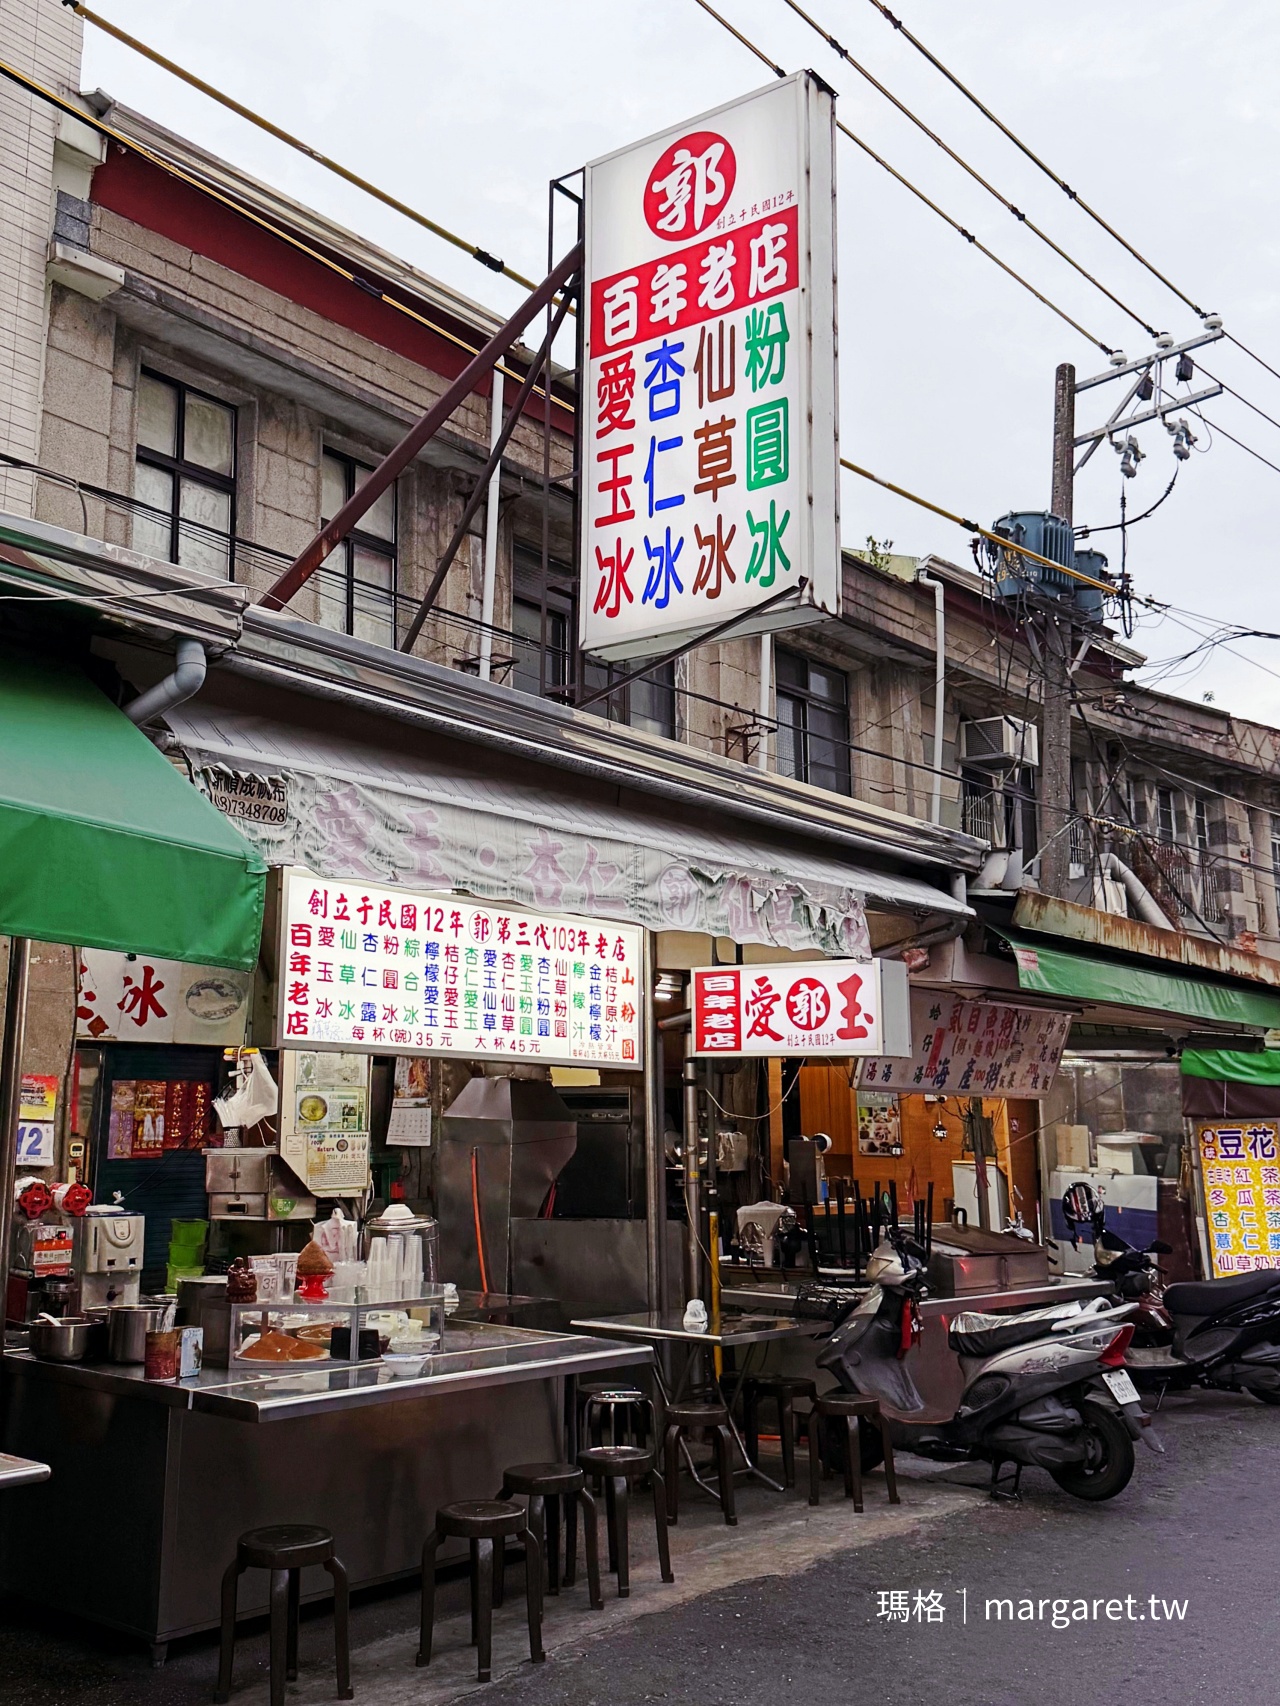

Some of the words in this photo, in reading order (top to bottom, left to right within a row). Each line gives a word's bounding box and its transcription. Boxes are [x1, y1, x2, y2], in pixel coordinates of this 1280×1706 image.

[652, 142, 725, 232] 郭
[603, 223, 788, 347] 百年老店
[593, 351, 636, 618] 愛玉冰
[641, 339, 685, 609] 杏仁冰
[692, 320, 737, 600] 仙草冰
[745, 301, 791, 588] 粉圓冰
[308, 889, 464, 938] 創立于民國12年
[473, 913, 490, 942] 郭
[497, 916, 626, 962] 第三代103年老店
[117, 965, 168, 1027] 冰
[286, 923, 313, 1036] 百年老店
[315, 926, 335, 1018] 愛玉冰
[338, 929, 357, 1020] 仙草冰
[361, 933, 379, 1023] 杏仁露
[381, 935, 400, 1024] 粉圓冰
[403, 938, 421, 1025] 綜合冰
[424, 941, 440, 1028] 檸檬愛玉
[444, 943, 459, 1030] 桔仔愛玉
[463, 946, 479, 1031] 杏仁愛玉
[482, 949, 498, 1032] 愛玉仙草
[501, 952, 516, 1033] 杏仁仙草
[519, 954, 533, 1036] 愛玉粉圓
[537, 956, 551, 1037] 杏仁粉圓
[554, 958, 568, 1038] 仙草粉圓
[572, 961, 586, 1040] 檸檬汁
[589, 963, 602, 1042] 金桔檸檬
[605, 966, 618, 1043] 桔仔原汁
[620, 967, 636, 1061] 山粉圓
[703, 975, 737, 1049] 百年老店
[352, 1025, 453, 1047] 每杯(碗)35元
[475, 1034, 541, 1054] 大杯45元
[1217, 1127, 1275, 1160] 豆花
[1210, 1189, 1280, 1206] 冬瓜茶
[1213, 1211, 1280, 1228] 杏仁茶
